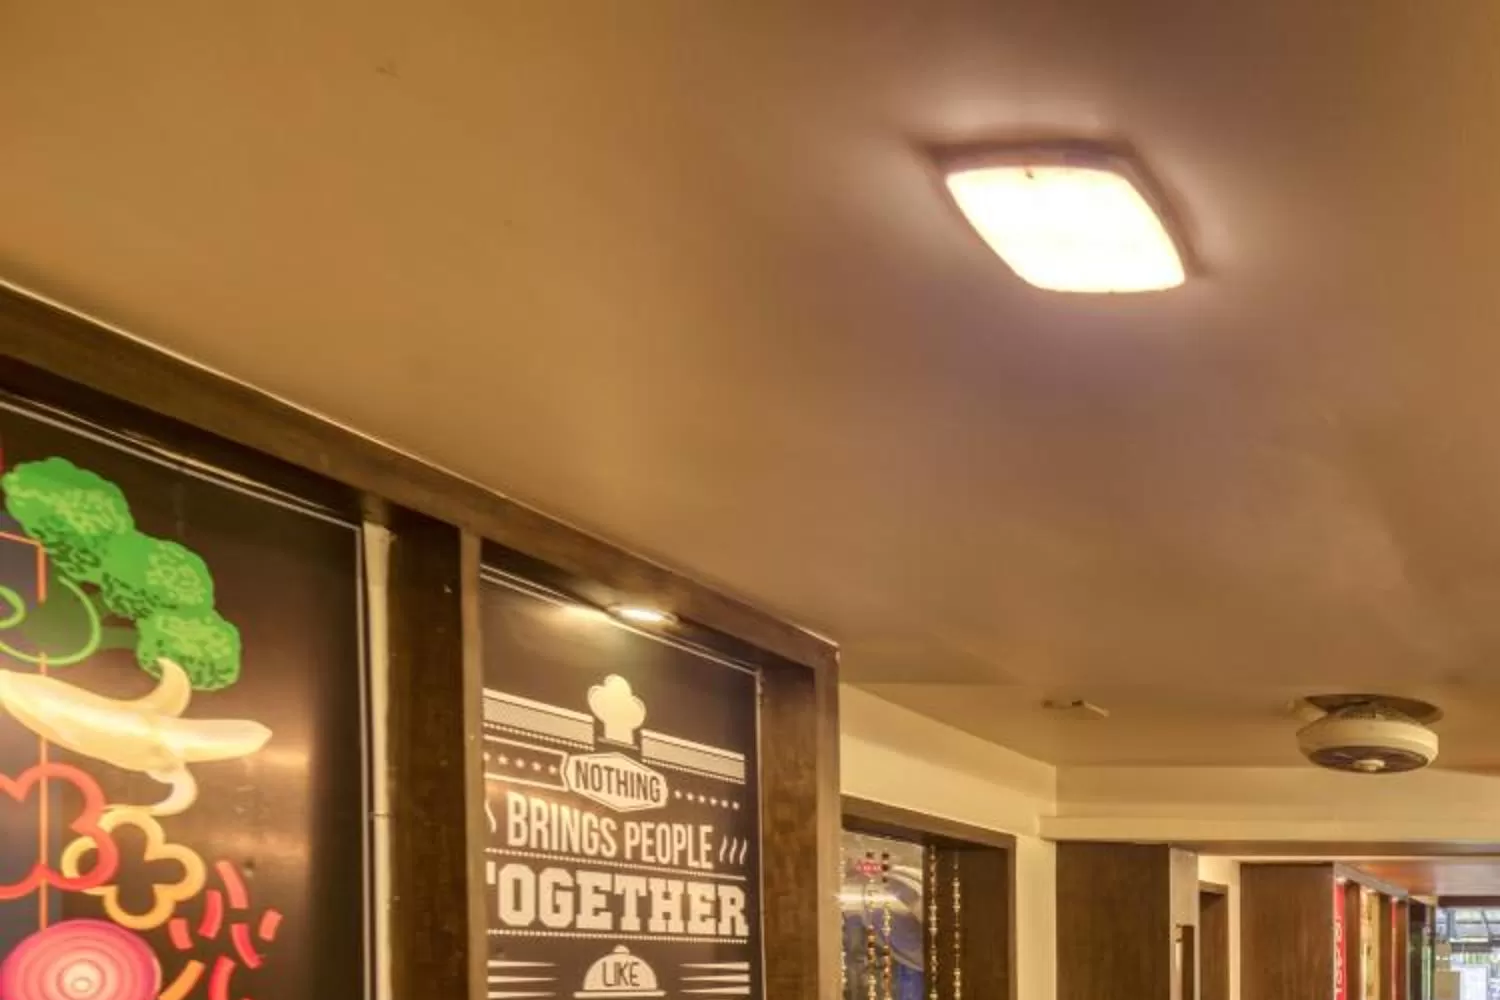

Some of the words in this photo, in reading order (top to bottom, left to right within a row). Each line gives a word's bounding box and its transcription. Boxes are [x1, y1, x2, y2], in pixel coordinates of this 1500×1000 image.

[575, 759, 662, 803] NOTHING
[506, 791, 618, 859] BRINGS
[624, 821, 714, 869] PEOPLE
[602, 961, 641, 987] LIKE
